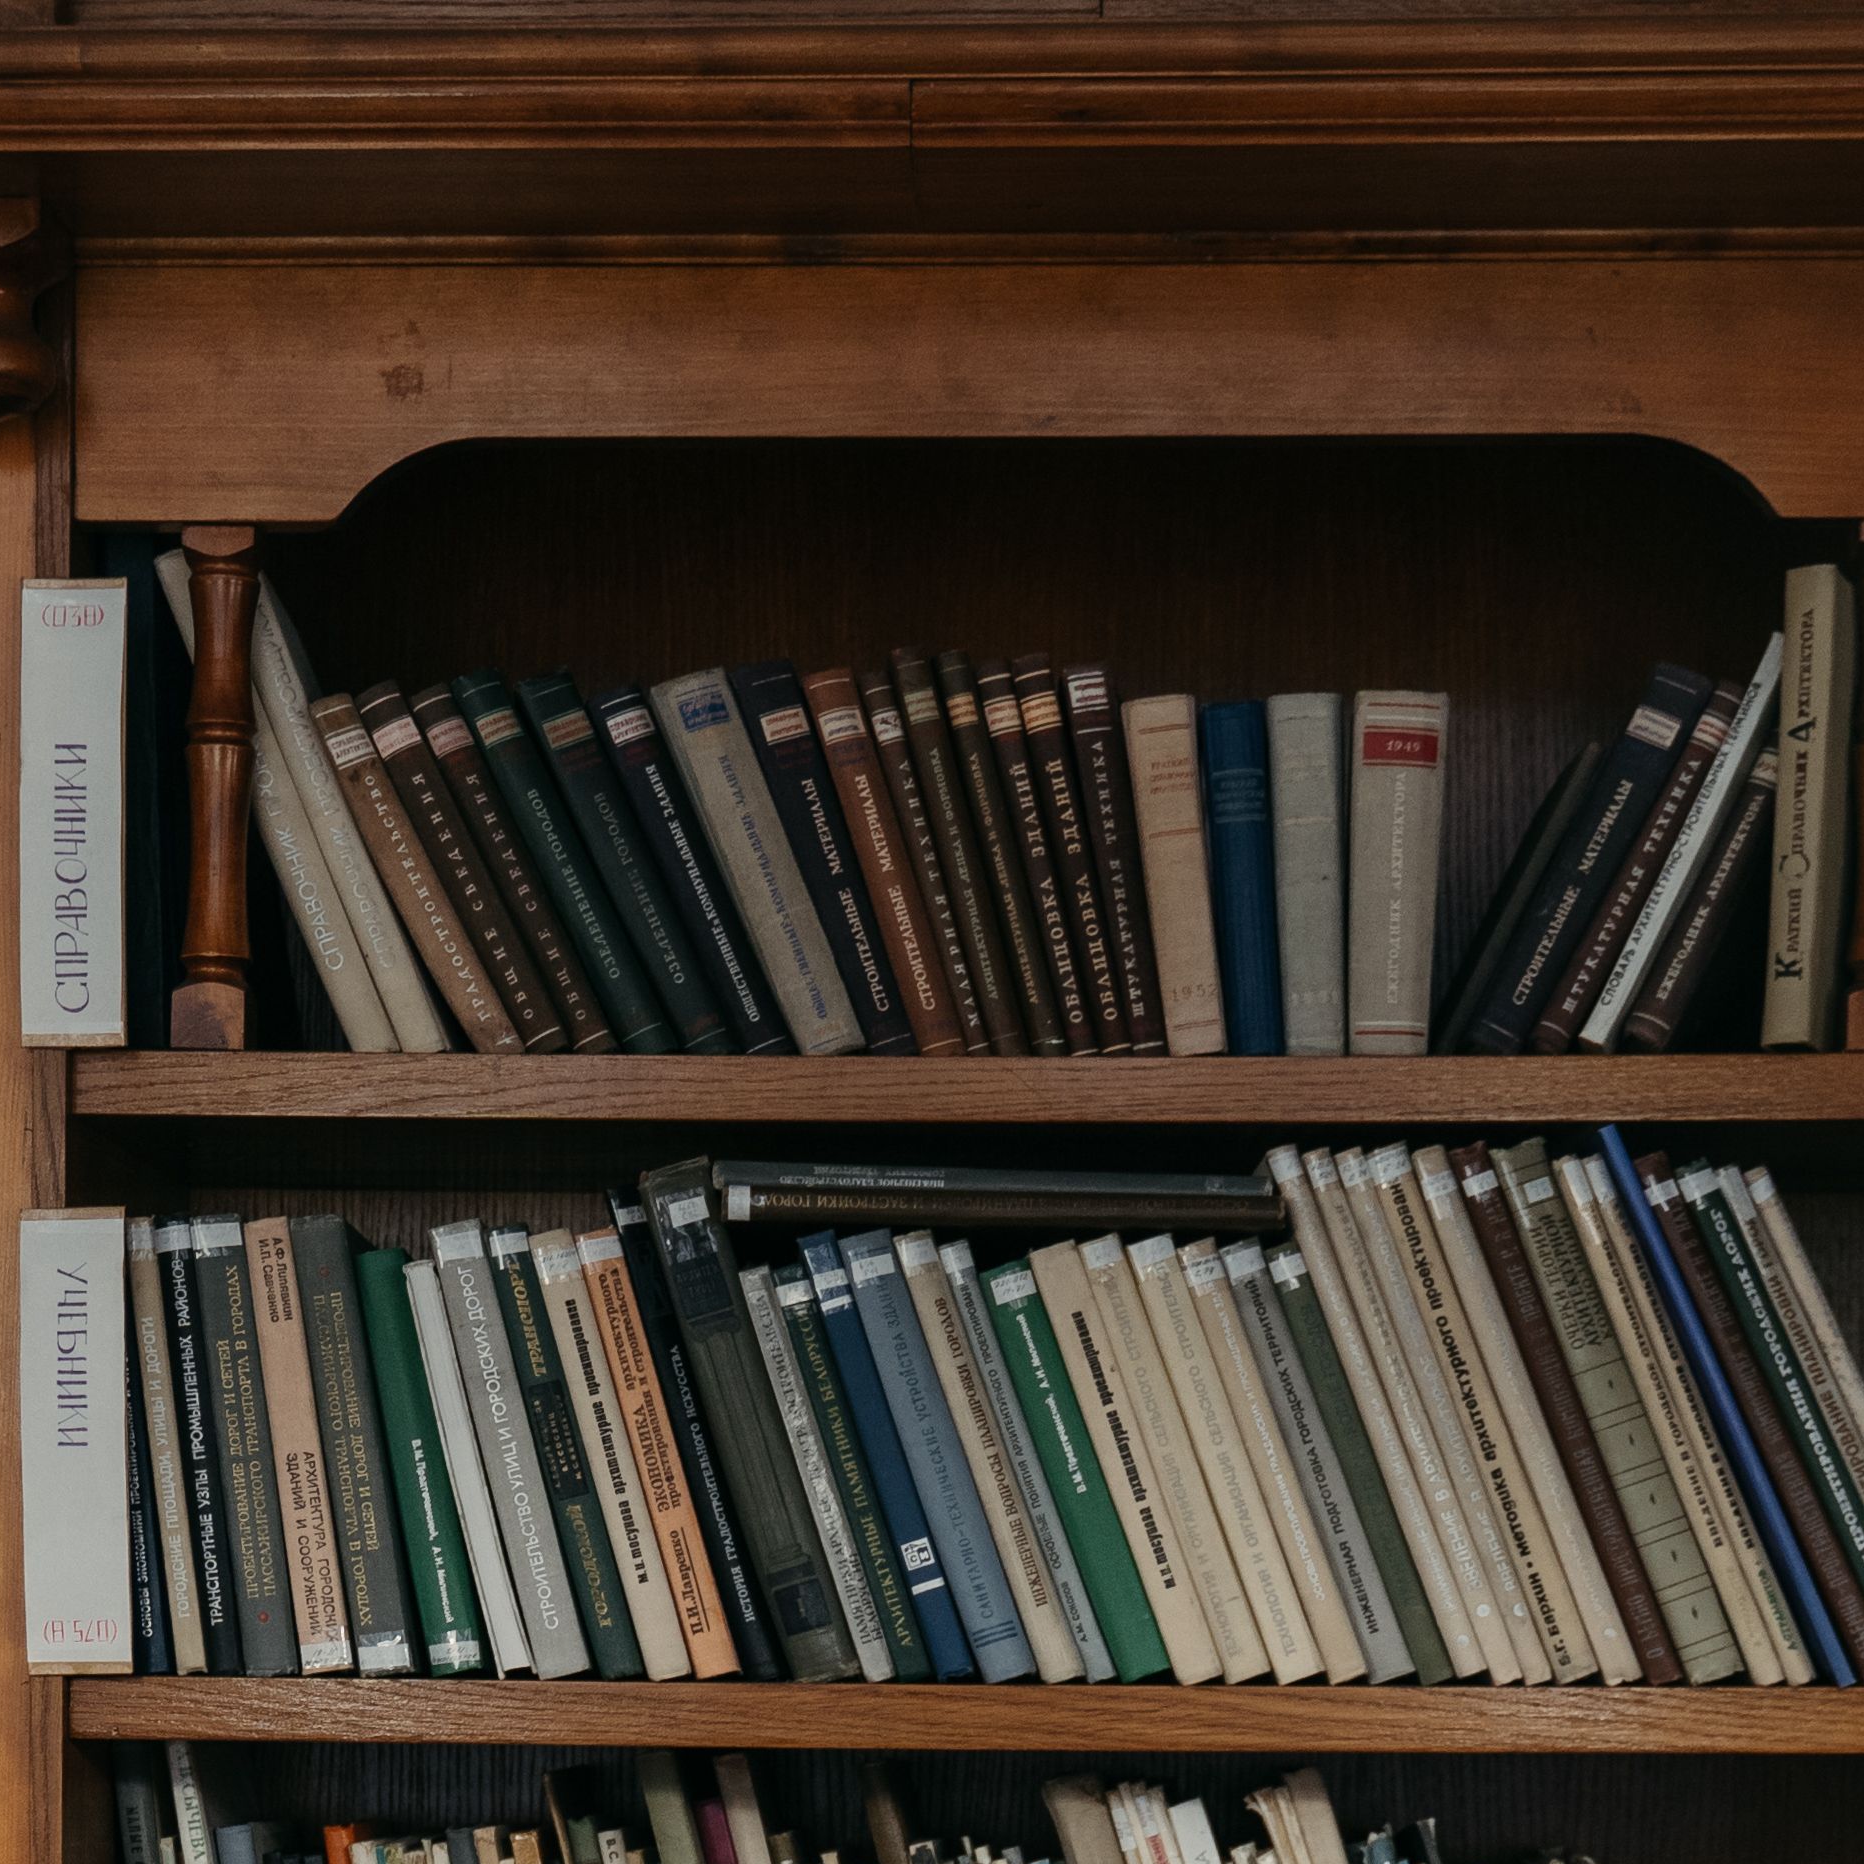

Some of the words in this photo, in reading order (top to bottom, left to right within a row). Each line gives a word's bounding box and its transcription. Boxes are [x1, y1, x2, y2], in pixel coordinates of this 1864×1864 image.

[1384, 739, 1422, 754] 1949
[800, 776, 844, 875] МАТЕРИАЛЫ
[1008, 760, 1045, 858] ЗДАНИЙ
[53, 743, 89, 1013] СПРАВОЧНИКИ
[362, 771, 492, 1022] ГРАДОСТРОИТЕЛЬСТВО
[838, 886, 891, 1012] СТРОИТЕЛЬНЫЕ
[1037, 875, 1084, 1024] ОБЛИЦОВКА
[456, 1262, 487, 1322] ДОРОГ
[56, 1262, 87, 1446] УЧЕБНИКИ
[179, 1335, 206, 1459] ПРОМЫШЛЕННЫХ
[471, 1321, 512, 1423] ГОРОДСКИХ
[497, 1426, 513, 1440] И
[1276, 1366, 1314, 1445] ГОРОДСКИХ
[193, 1468, 211, 1508] УЗЛЫ
[500, 1441, 528, 1489] УЛИЦ
[631, 1403, 671, 1513] ЭКОНОМИКА
[1304, 1446, 1346, 1534] ПОДГОТОВКА
[199, 1513, 224, 1625] ТРАНСПОРТНЫЕ
[513, 1490, 561, 1630] СТРОИТЕЛЬСТВО
[667, 1527, 706, 1635] П.И.Лавренко
[1337, 1539, 1381, 1634] ИНЖЕНЕРНАЯ
